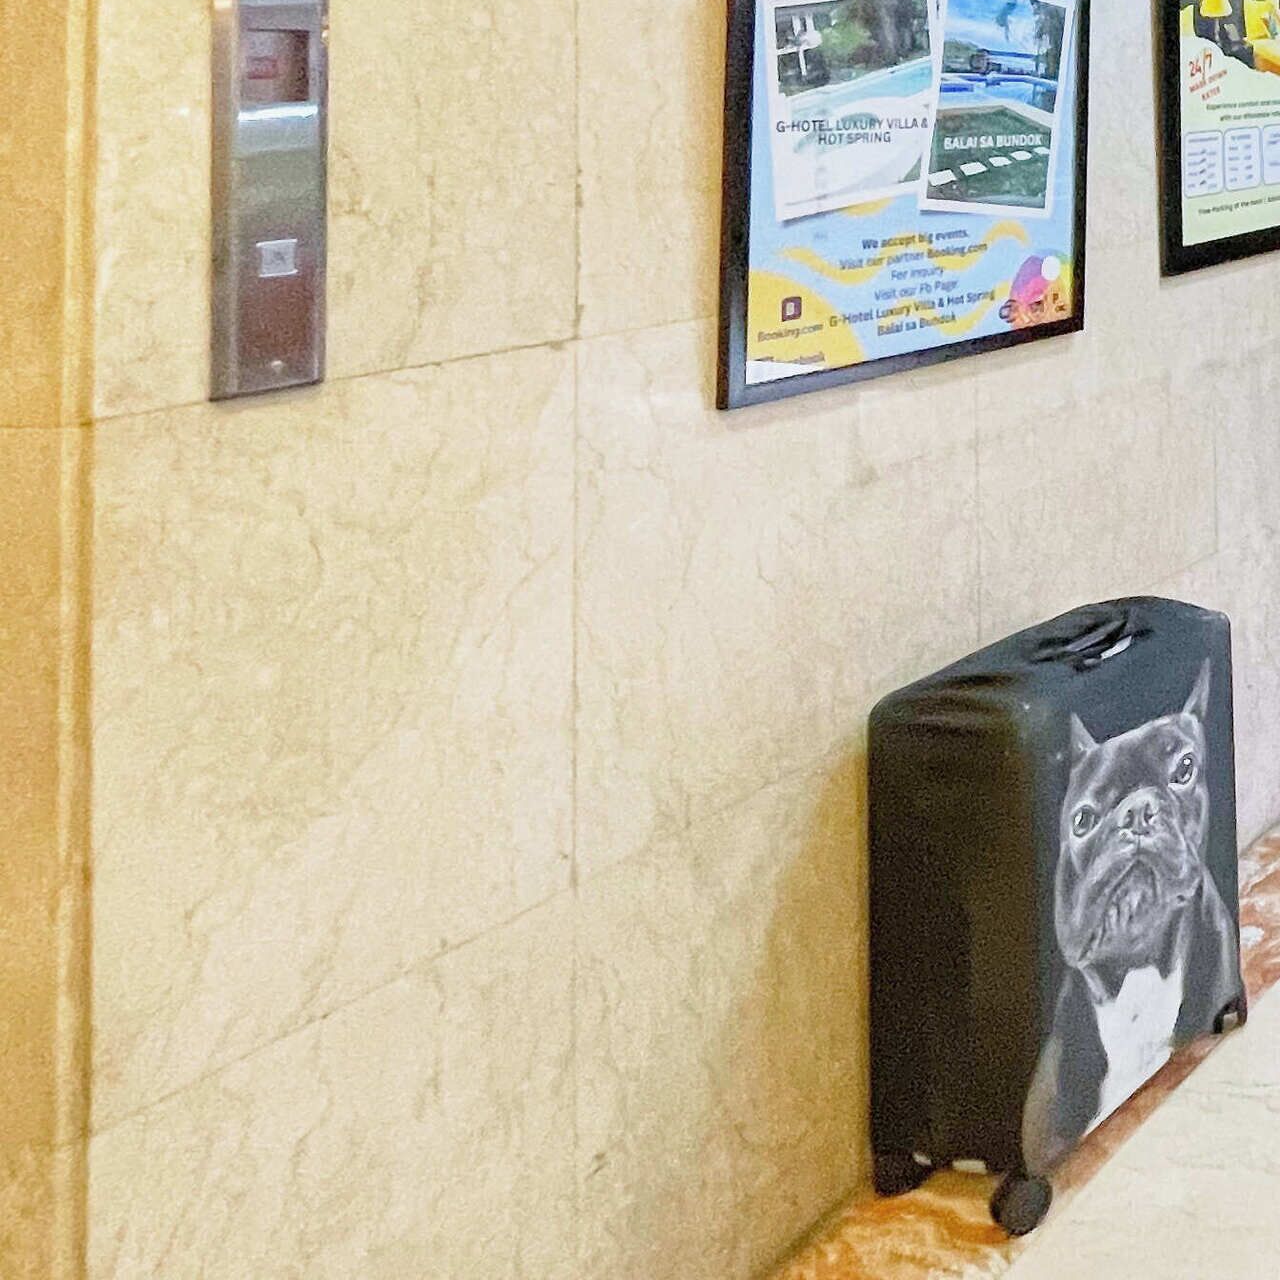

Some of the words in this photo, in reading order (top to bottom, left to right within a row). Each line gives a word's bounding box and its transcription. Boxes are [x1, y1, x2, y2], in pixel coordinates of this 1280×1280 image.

[776, 119, 833, 133] G-HOTEL
[835, 118, 883, 132] LUXURY
[886, 118, 919, 131] VILLA
[920, 118, 929, 130] &
[818, 132, 844, 145] HOT
[847, 130, 891, 145] SPRING
[943, 135, 978, 151] BALAI
[979, 135, 994, 149] SA
[996, 133, 1044, 148] BUNDOK
[862, 238, 879, 249] We
[881, 235, 915, 249] accept
[886, 251, 925, 267] partner
[927, 243, 988, 259] Booking.com
[829, 308, 873, 328] G-Hotel
[876, 304, 911, 319] Luxury
[913, 299, 936, 312] Villa
[938, 297, 945, 308] &
[947, 293, 965, 306] Hot
[877, 321, 904, 336] Balai
[905, 319, 917, 331] sa
